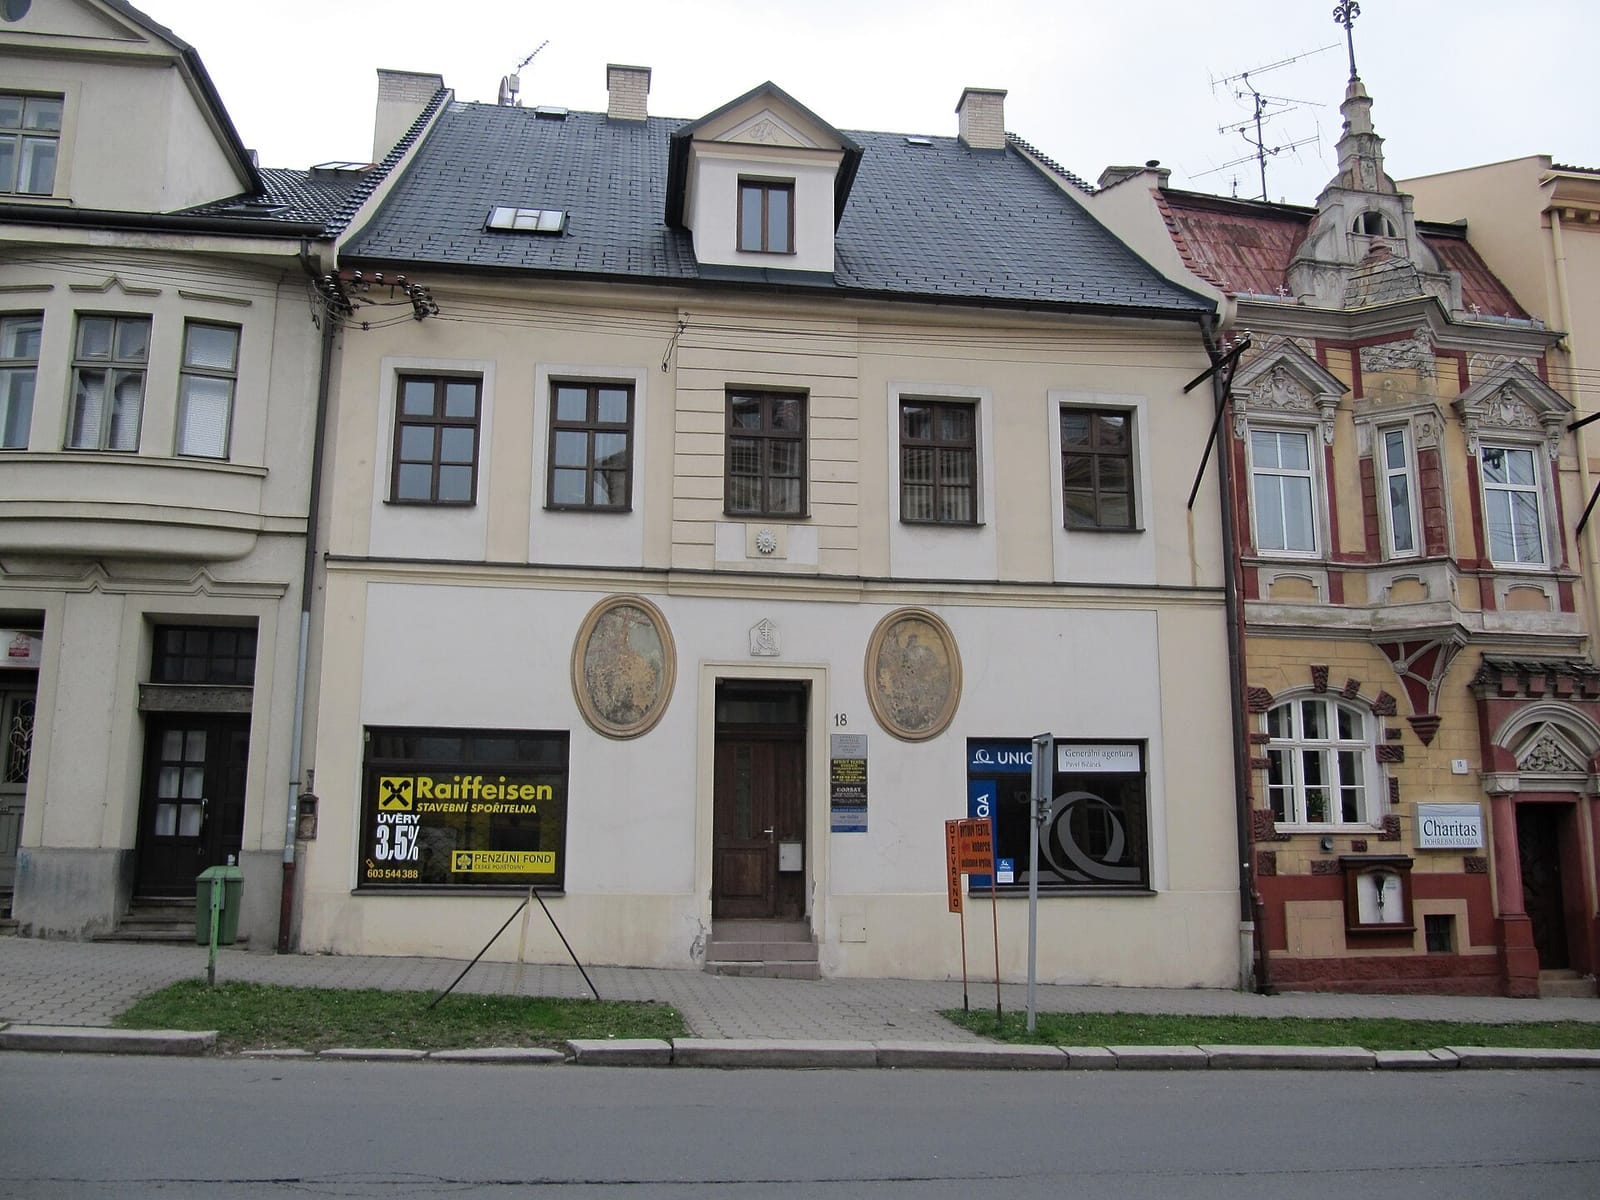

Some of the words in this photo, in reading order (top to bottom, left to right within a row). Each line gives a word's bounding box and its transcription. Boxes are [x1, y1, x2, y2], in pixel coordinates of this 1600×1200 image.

[834, 713, 848, 727] 18
[997, 751, 1032, 765] UNIQ
[1101, 749, 1134, 761] agentura
[416, 776, 553, 800] Raiffeisen
[416, 802, 468, 813] STAVEBNÍ
[470, 803, 537, 814] SPOŘITELNA
[377, 812, 421, 824] ÚVĚRY
[1423, 819, 1477, 837] Charitas
[375, 825, 420, 861] 3,5%
[523, 854, 552, 864] FOND
[367, 869, 384, 879] 603
[385, 869, 401, 879] 544
[402, 869, 418, 879] 388
